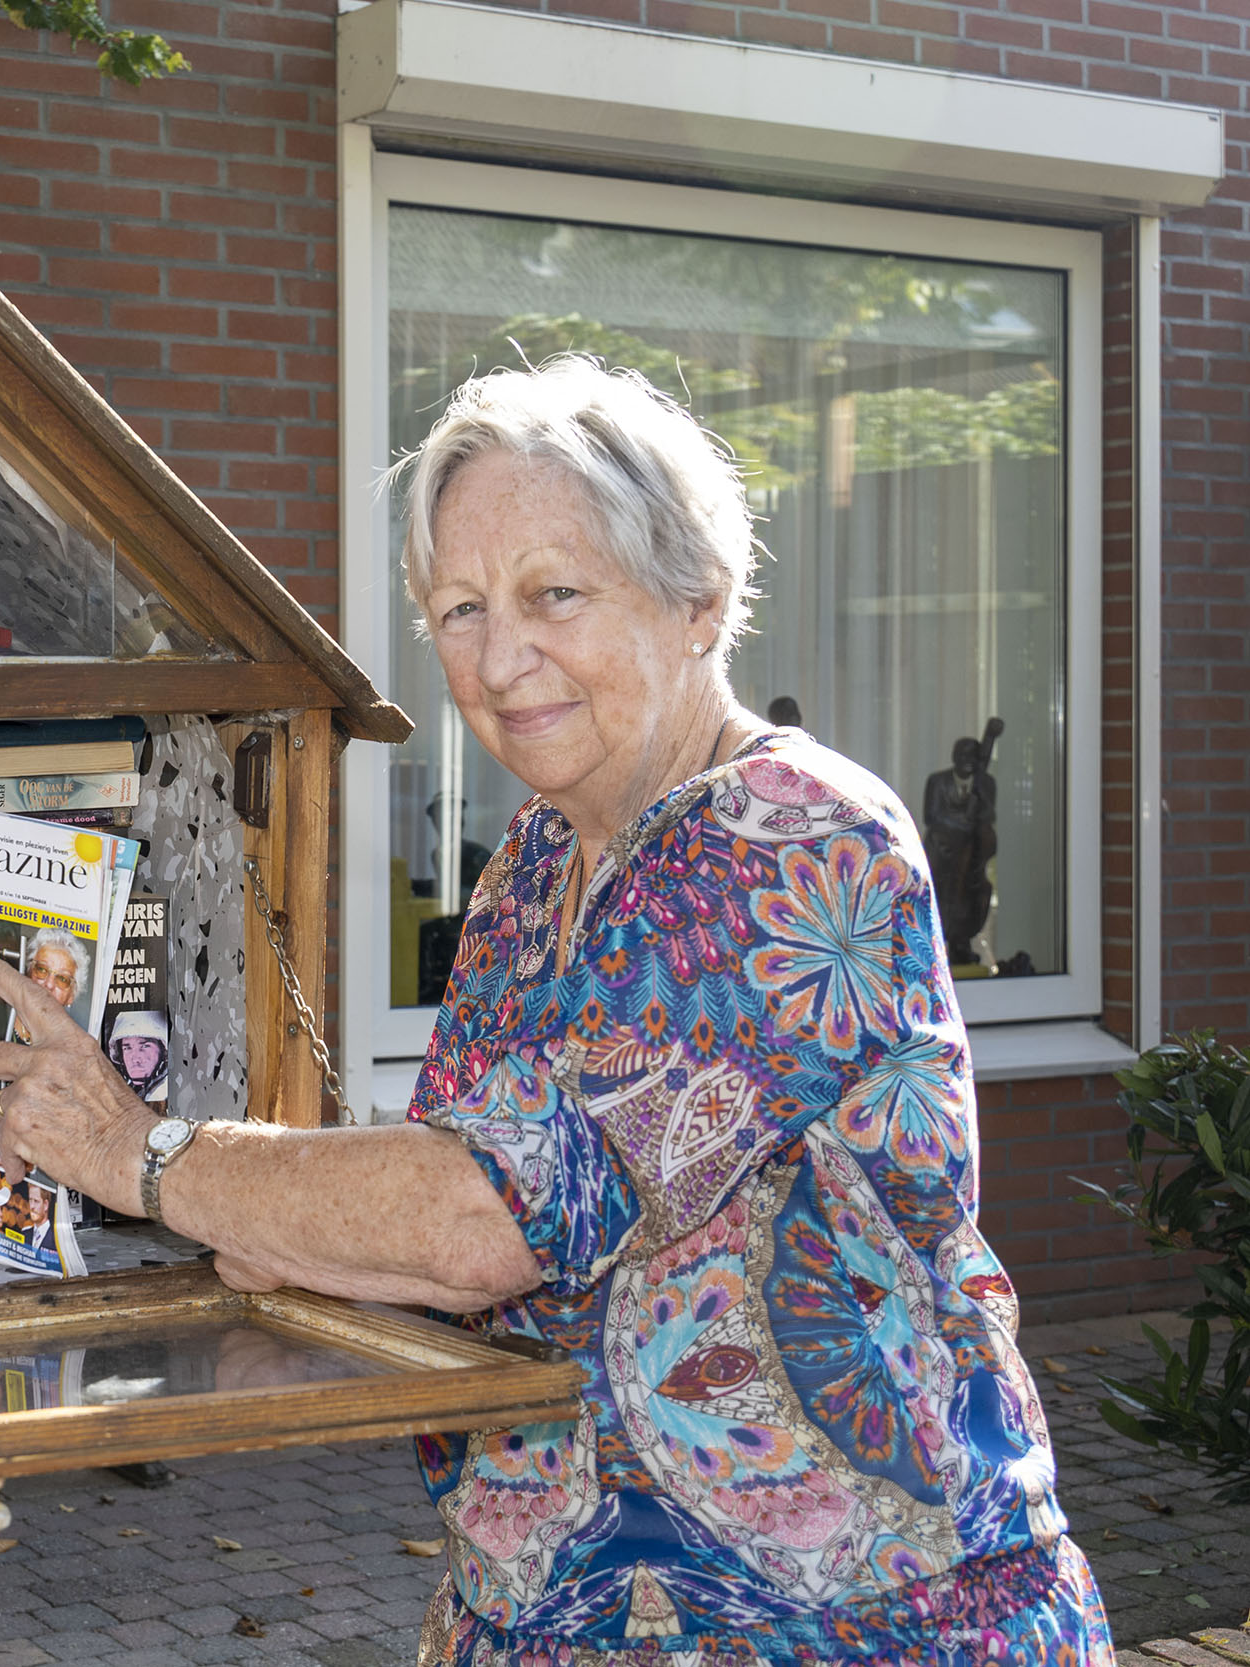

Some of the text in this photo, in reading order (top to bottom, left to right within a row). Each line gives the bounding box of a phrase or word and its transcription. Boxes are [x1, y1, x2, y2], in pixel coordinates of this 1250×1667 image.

[45, 782, 74, 793] VAN DE
[25, 840, 51, 852] plezierig
[52, 847, 69, 856] leven
[41, 914, 91, 934] MAGAZINE
[108, 987, 146, 1004] MAN
